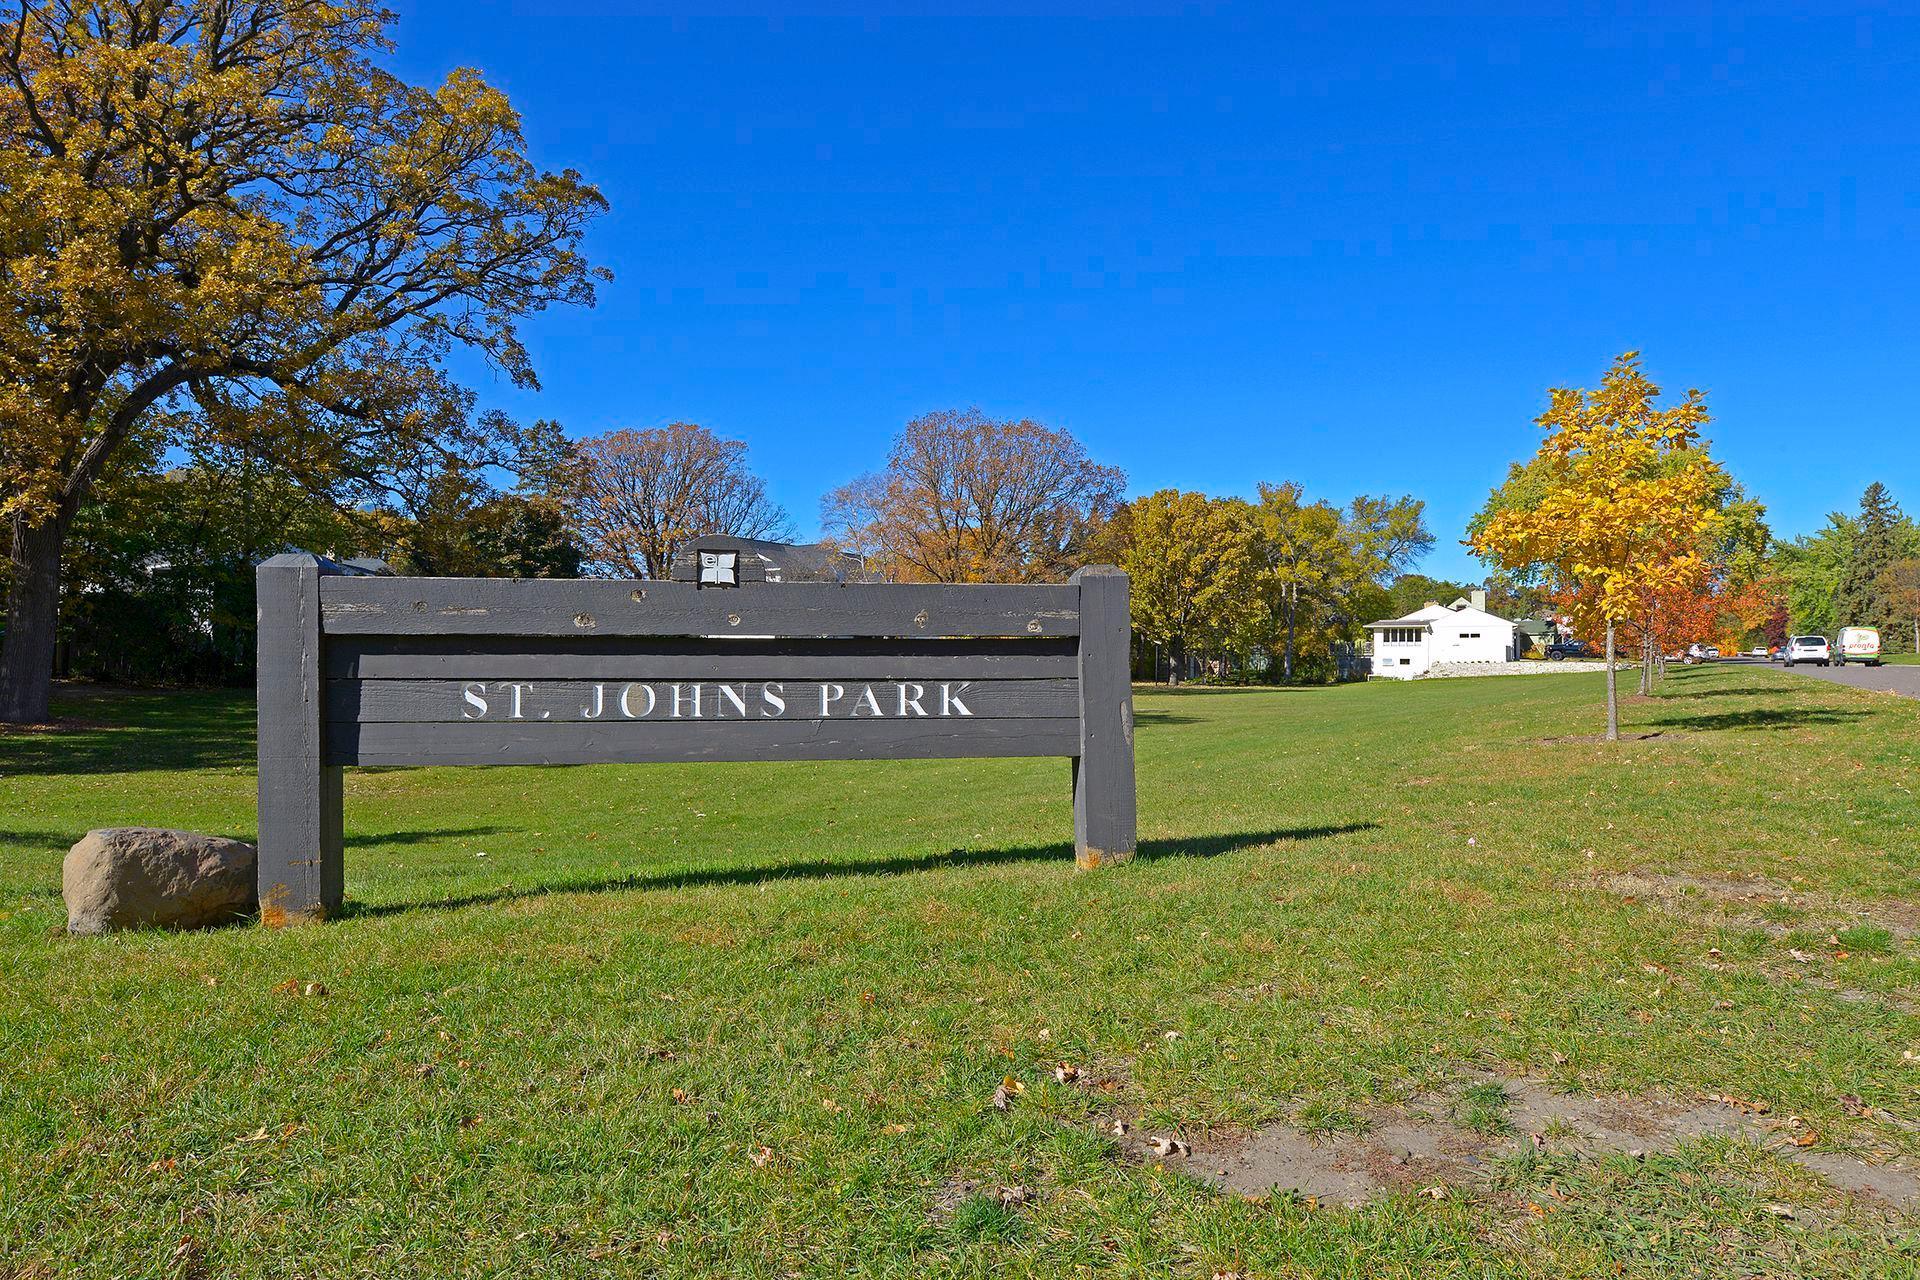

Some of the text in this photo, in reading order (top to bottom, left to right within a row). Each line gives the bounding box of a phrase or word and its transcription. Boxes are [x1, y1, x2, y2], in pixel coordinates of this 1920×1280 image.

[461, 681, 975, 719] ST. JOHNS PARK
